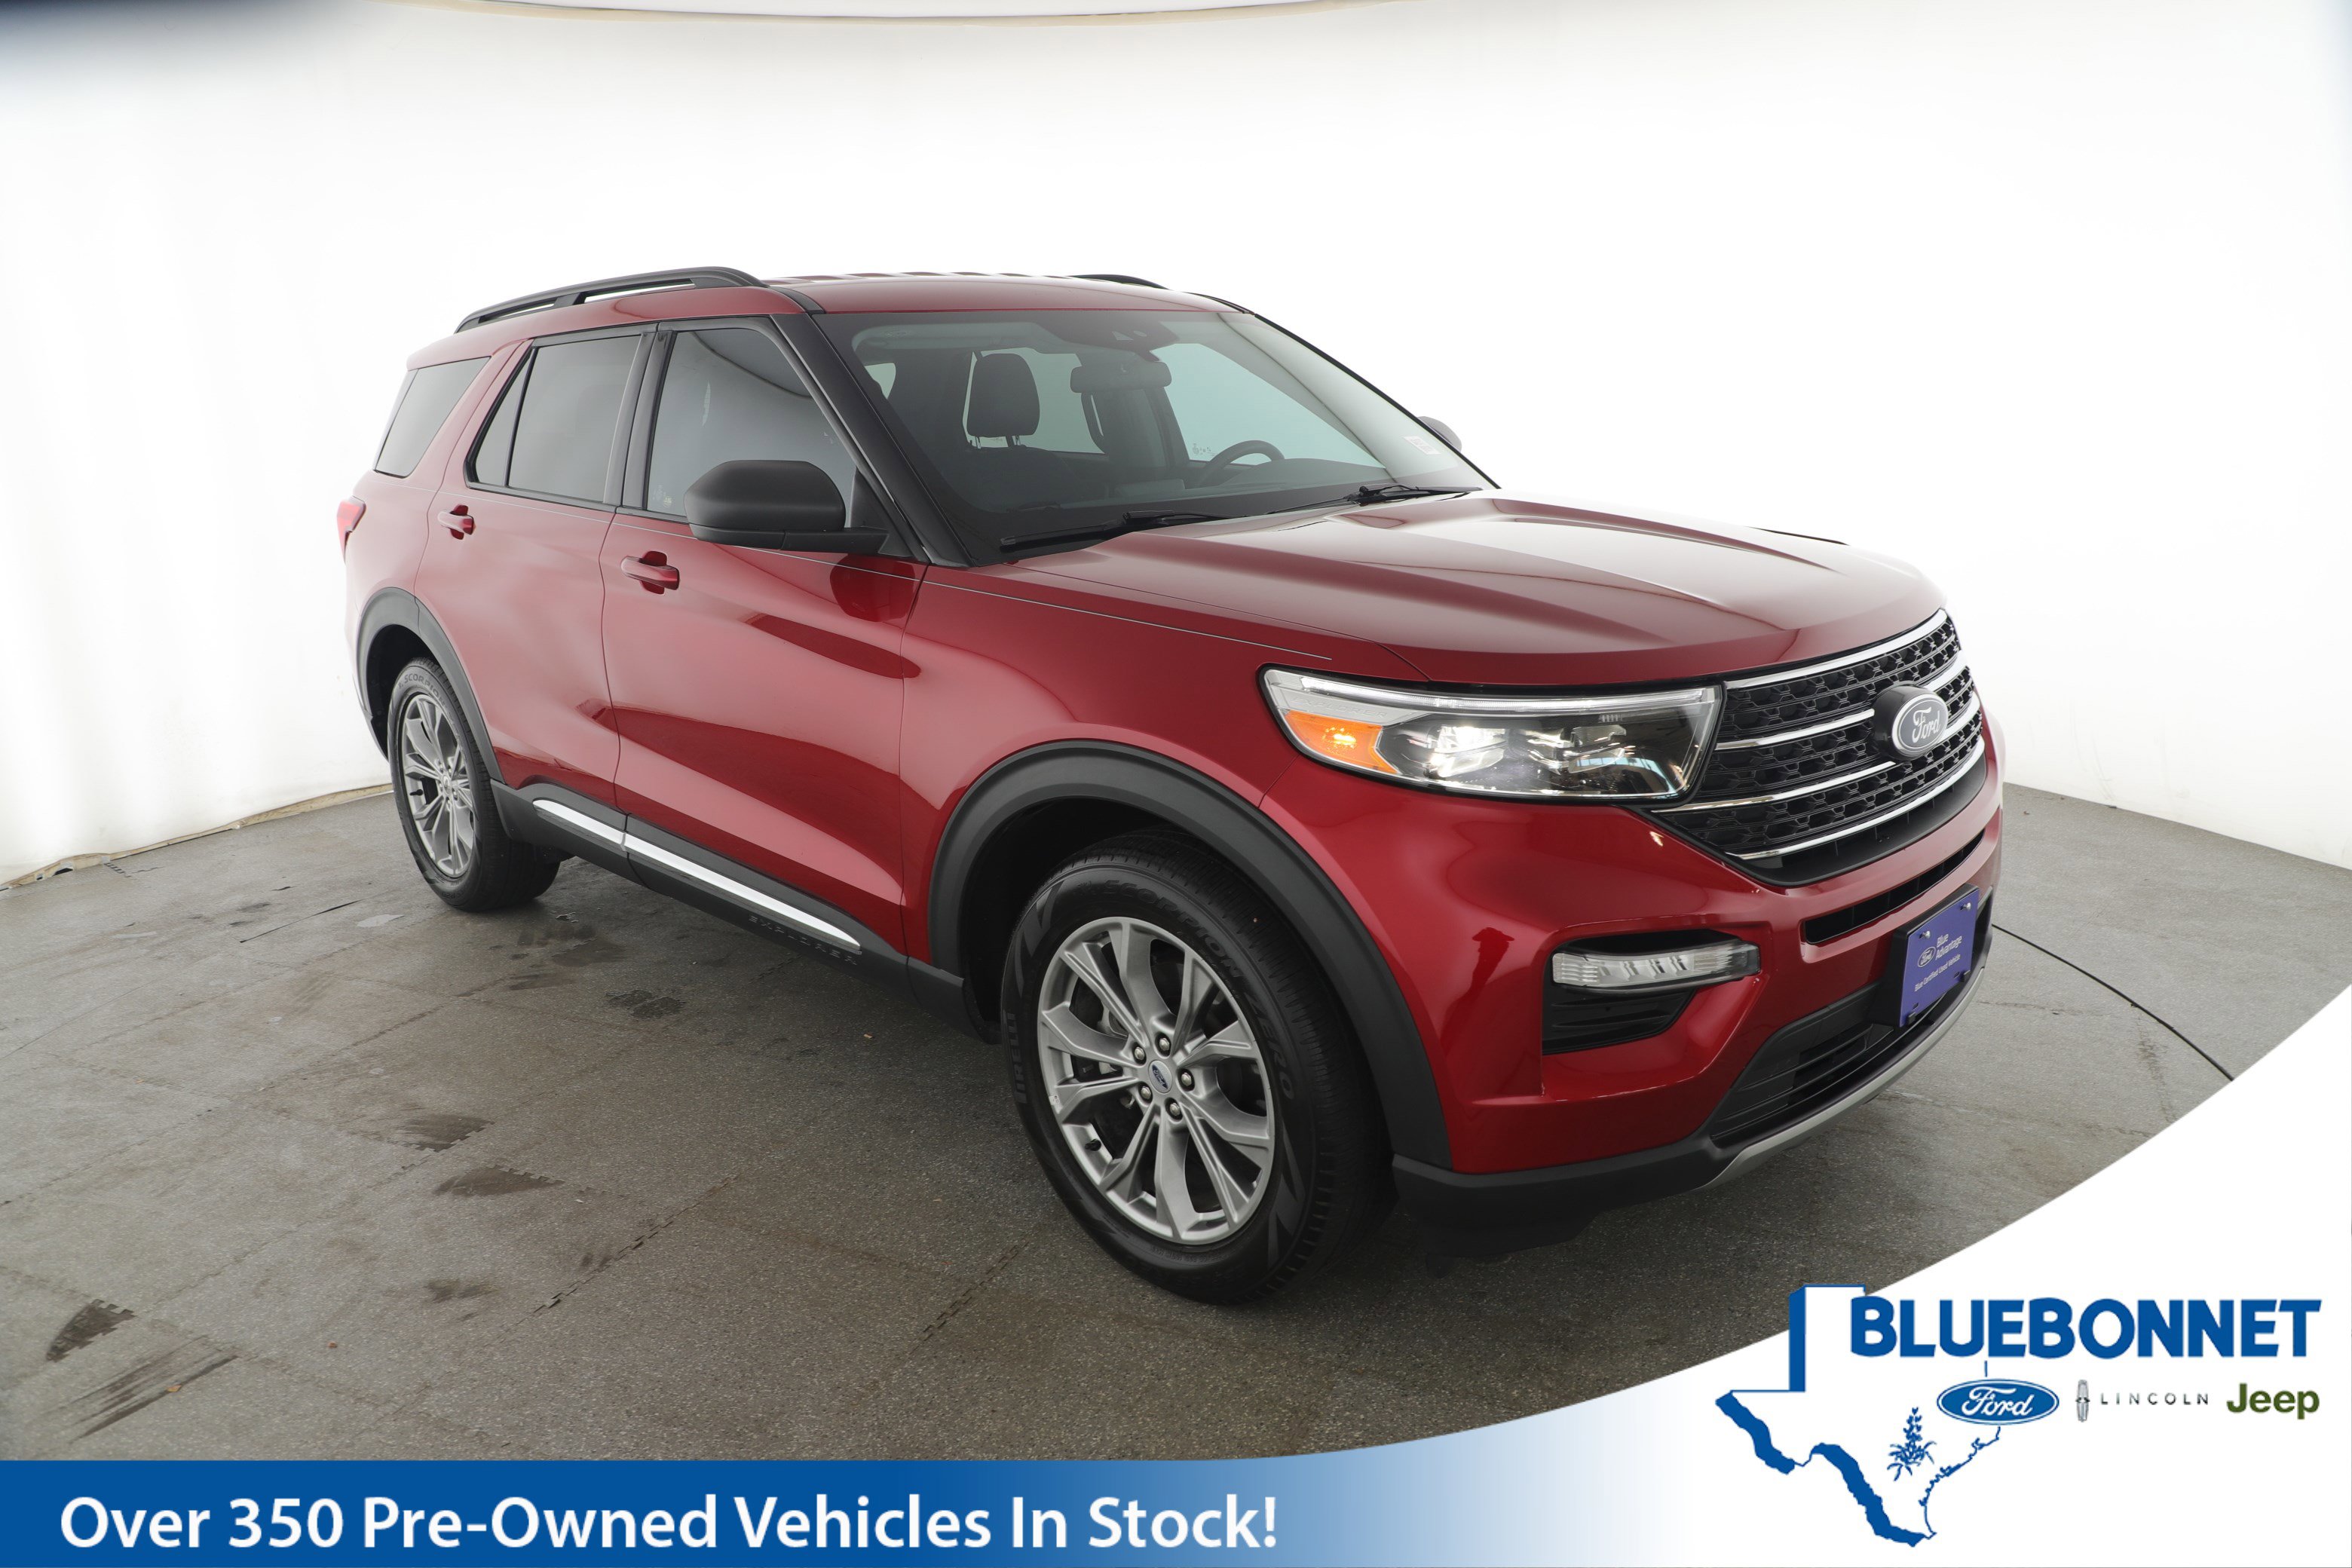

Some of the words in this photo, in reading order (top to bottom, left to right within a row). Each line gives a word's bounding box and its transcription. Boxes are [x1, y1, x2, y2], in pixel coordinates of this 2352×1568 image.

[1290, 697, 1388, 718] EXPLORER
[1912, 706, 1940, 743] Ford
[748, 914, 858, 966] EXPLORER
[1935, 936, 1962, 960] Advantage
[1936, 934, 1949, 948] Blue
[1103, 879, 1245, 978] SCORPION
[1244, 991, 1295, 1100] ZERO
[1915, 982, 1924, 992] Blue
[1923, 969, 1939, 985] Certified
[1938, 960, 1949, 973] Used
[1948, 954, 1961, 967] Vehicle
